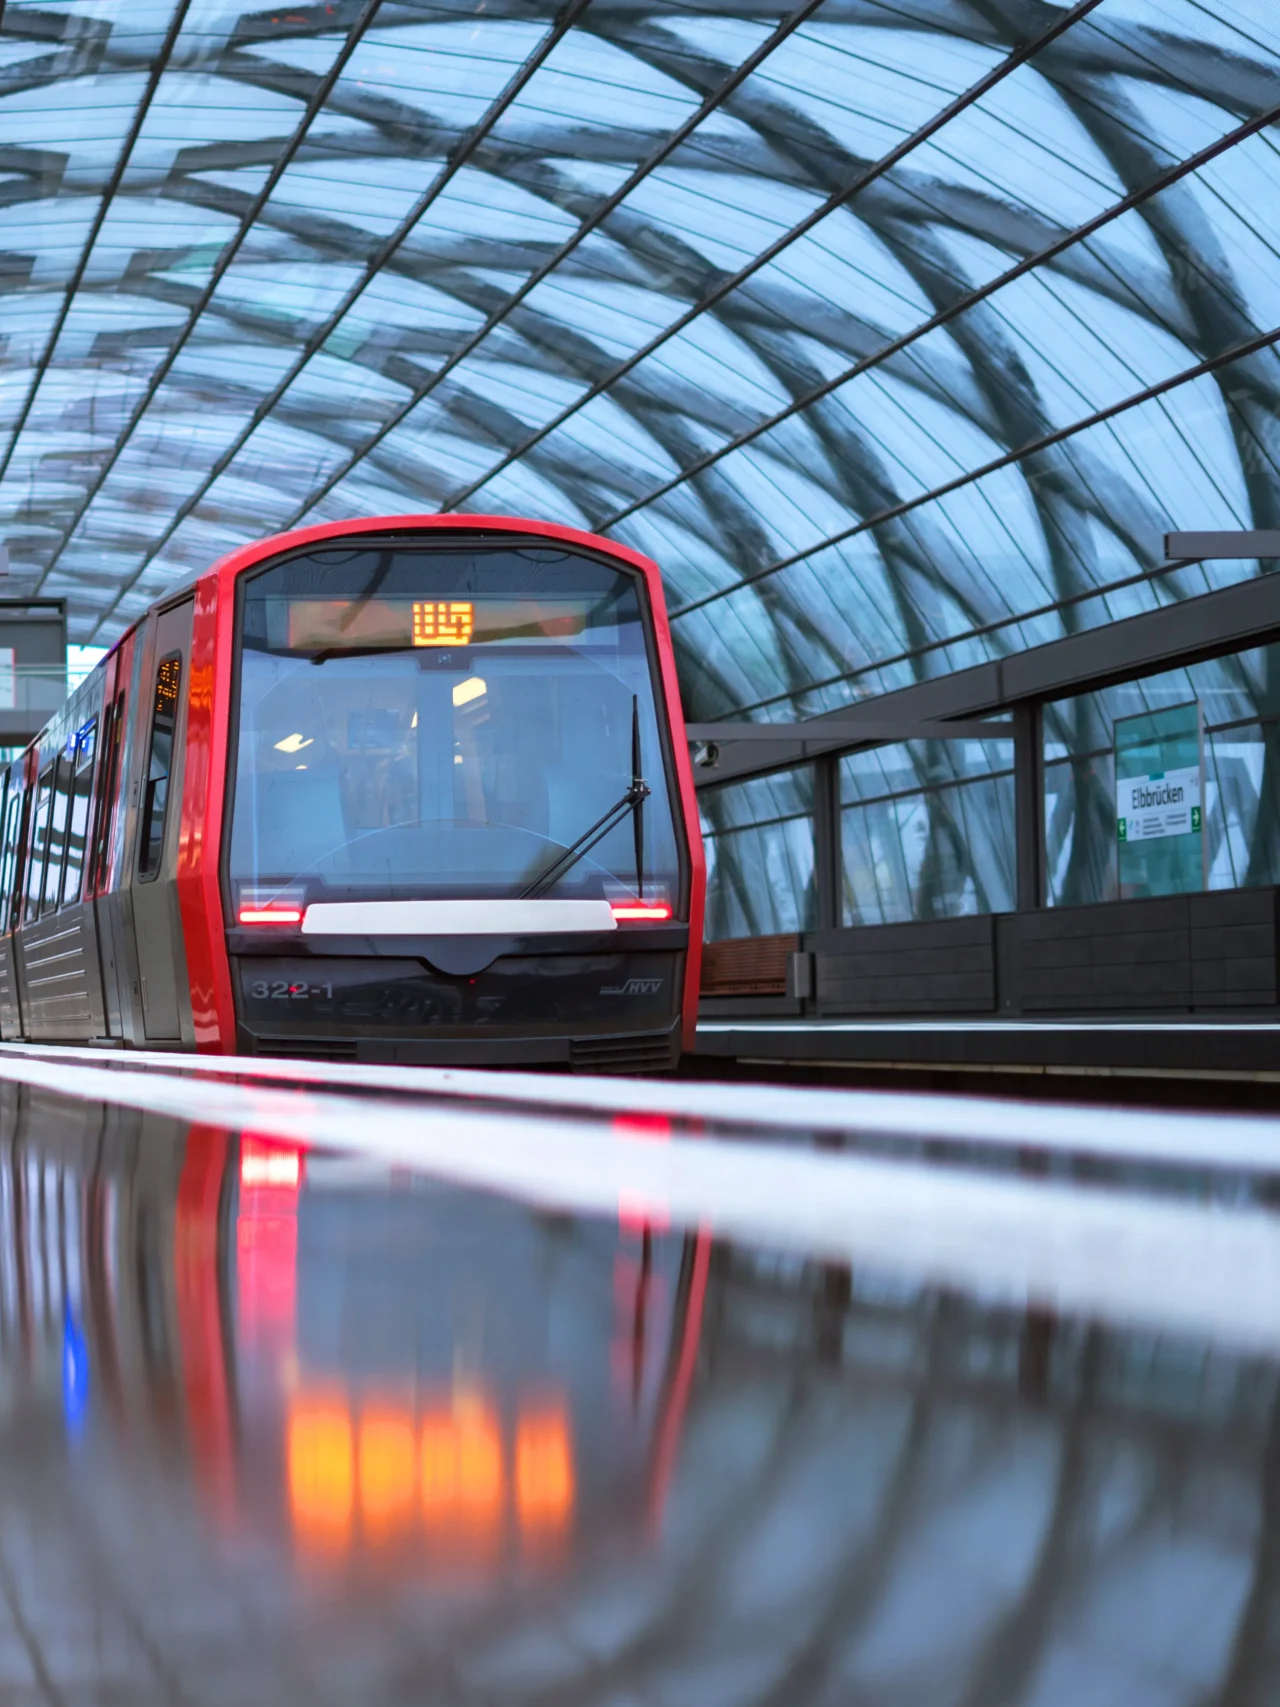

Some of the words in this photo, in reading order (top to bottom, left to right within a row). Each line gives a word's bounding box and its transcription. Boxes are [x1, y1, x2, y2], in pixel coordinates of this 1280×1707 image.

[1131, 783, 1184, 810] Elbbrücken
[251, 980, 333, 999] 322-1
[628, 982, 662, 993] HVV
